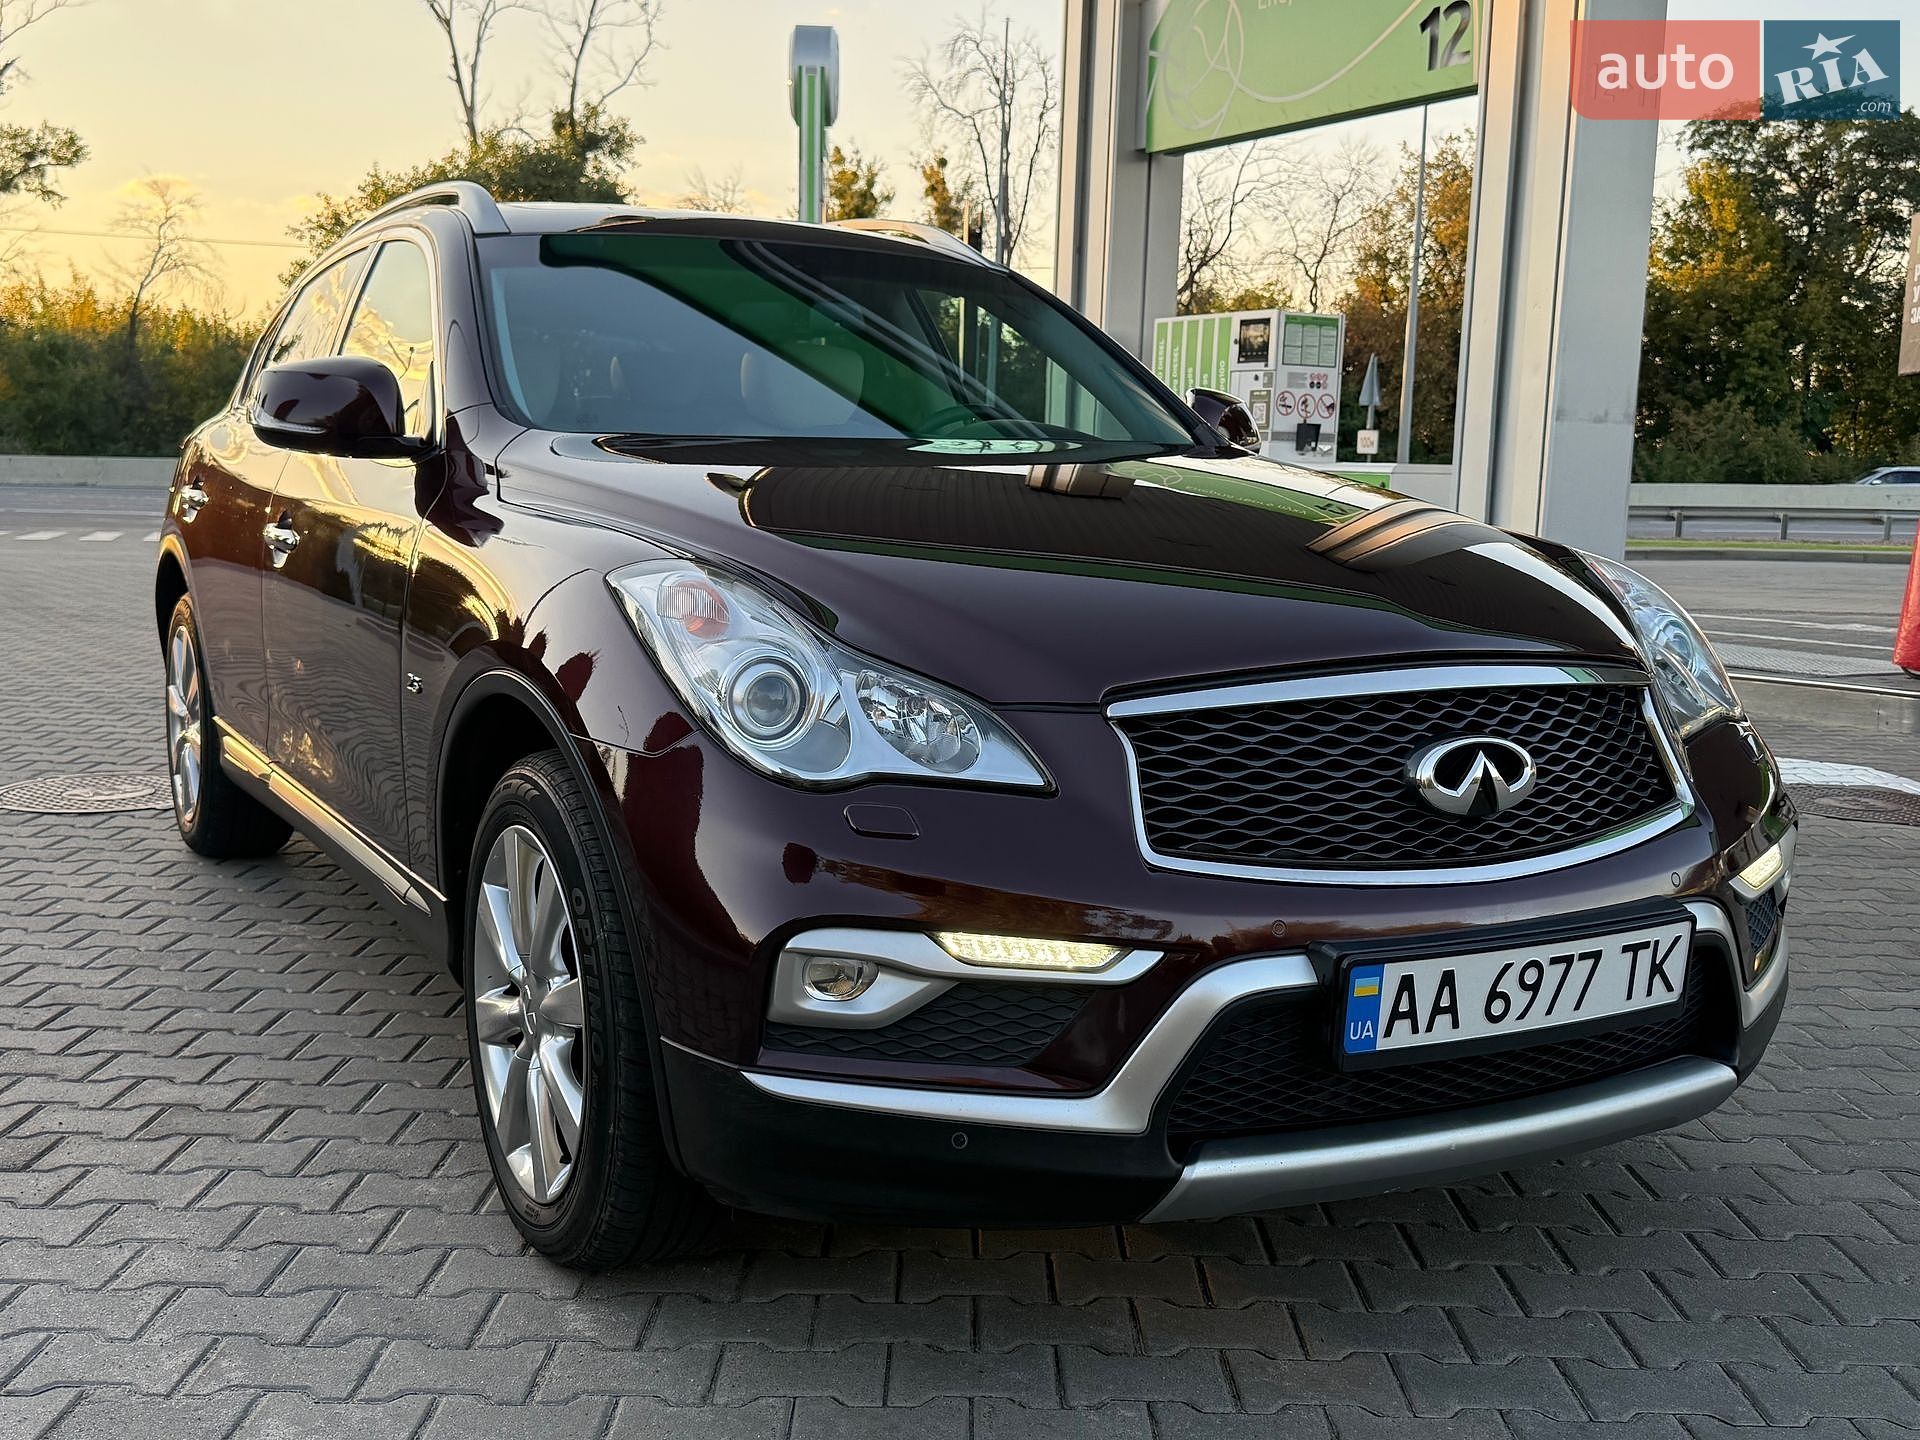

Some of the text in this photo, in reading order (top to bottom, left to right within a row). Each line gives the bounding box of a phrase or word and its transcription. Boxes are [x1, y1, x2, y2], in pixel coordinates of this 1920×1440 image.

[1419, 0, 1471, 71] 12
[571, 886, 604, 1068] OPTIMO
[1383, 934, 1683, 1038] AA 6977 TK
[1350, 1020, 1374, 1041] UA
